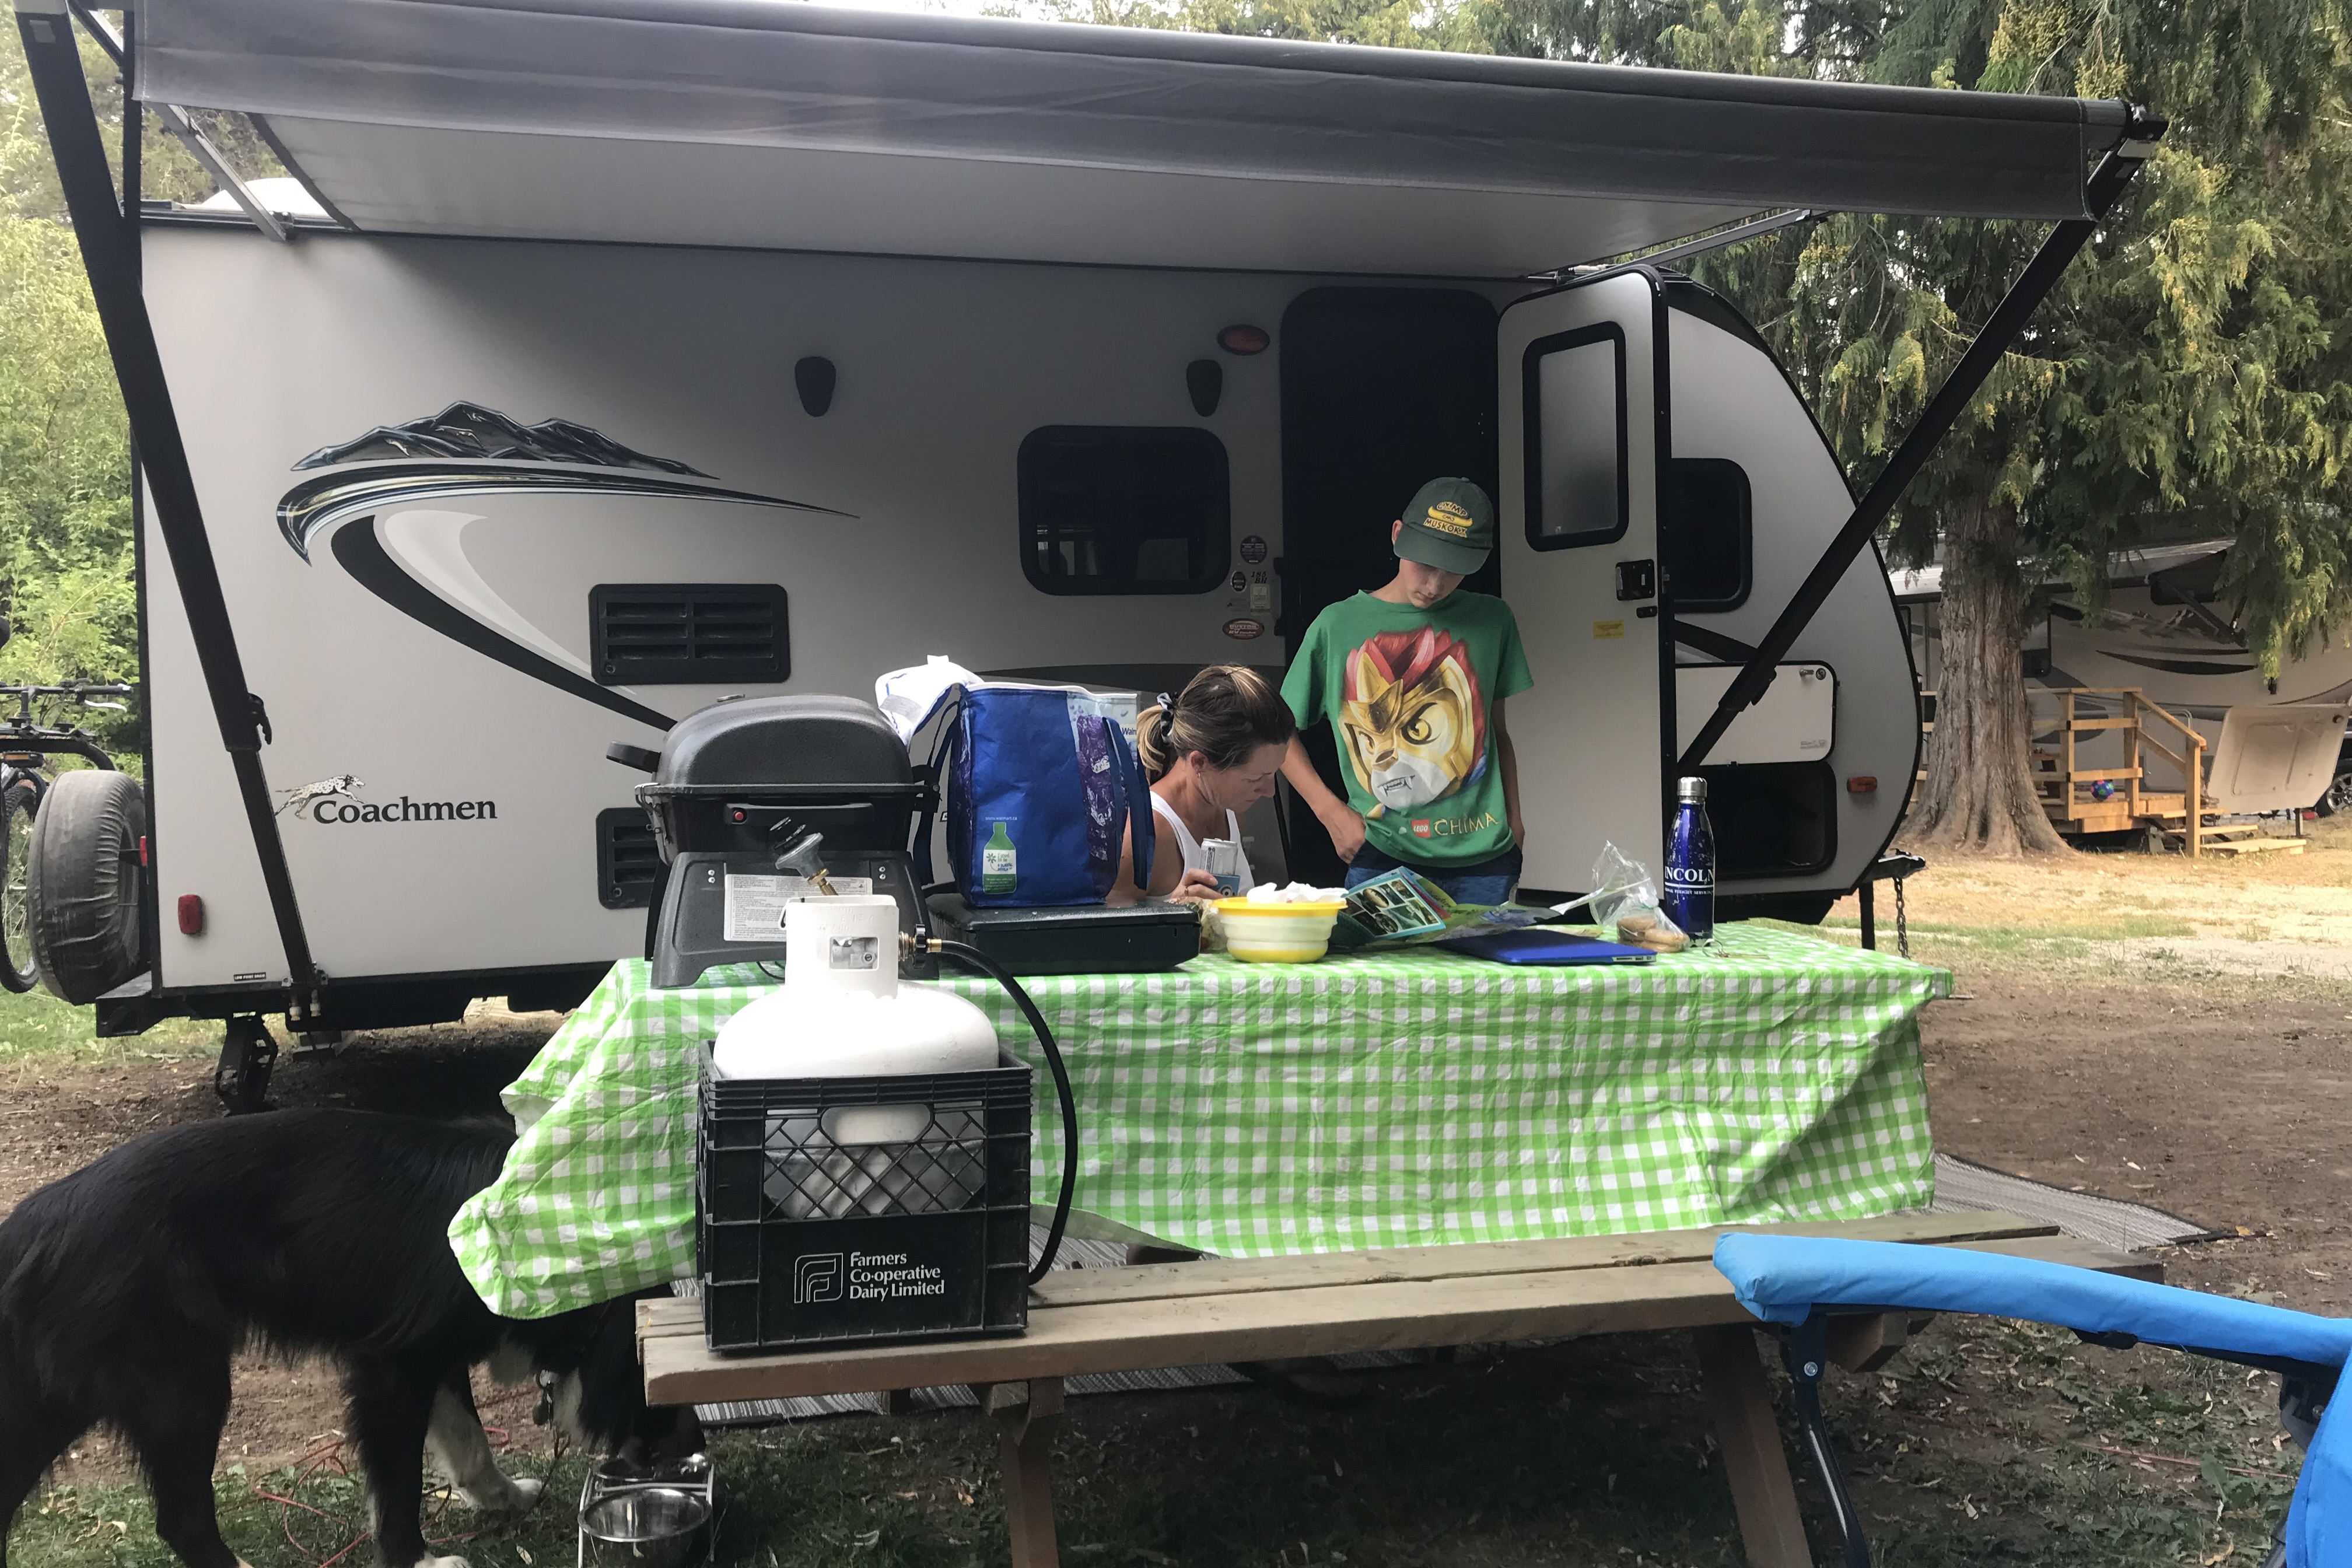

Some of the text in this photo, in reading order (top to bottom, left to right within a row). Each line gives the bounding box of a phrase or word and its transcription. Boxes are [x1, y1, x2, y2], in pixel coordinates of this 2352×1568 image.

[313, 796, 498, 824] Coachmen
[1413, 813, 1499, 835] LEGO CHIMA
[850, 1252, 907, 1267] Farmers
[850, 1280, 944, 1301] Dairy Limited
